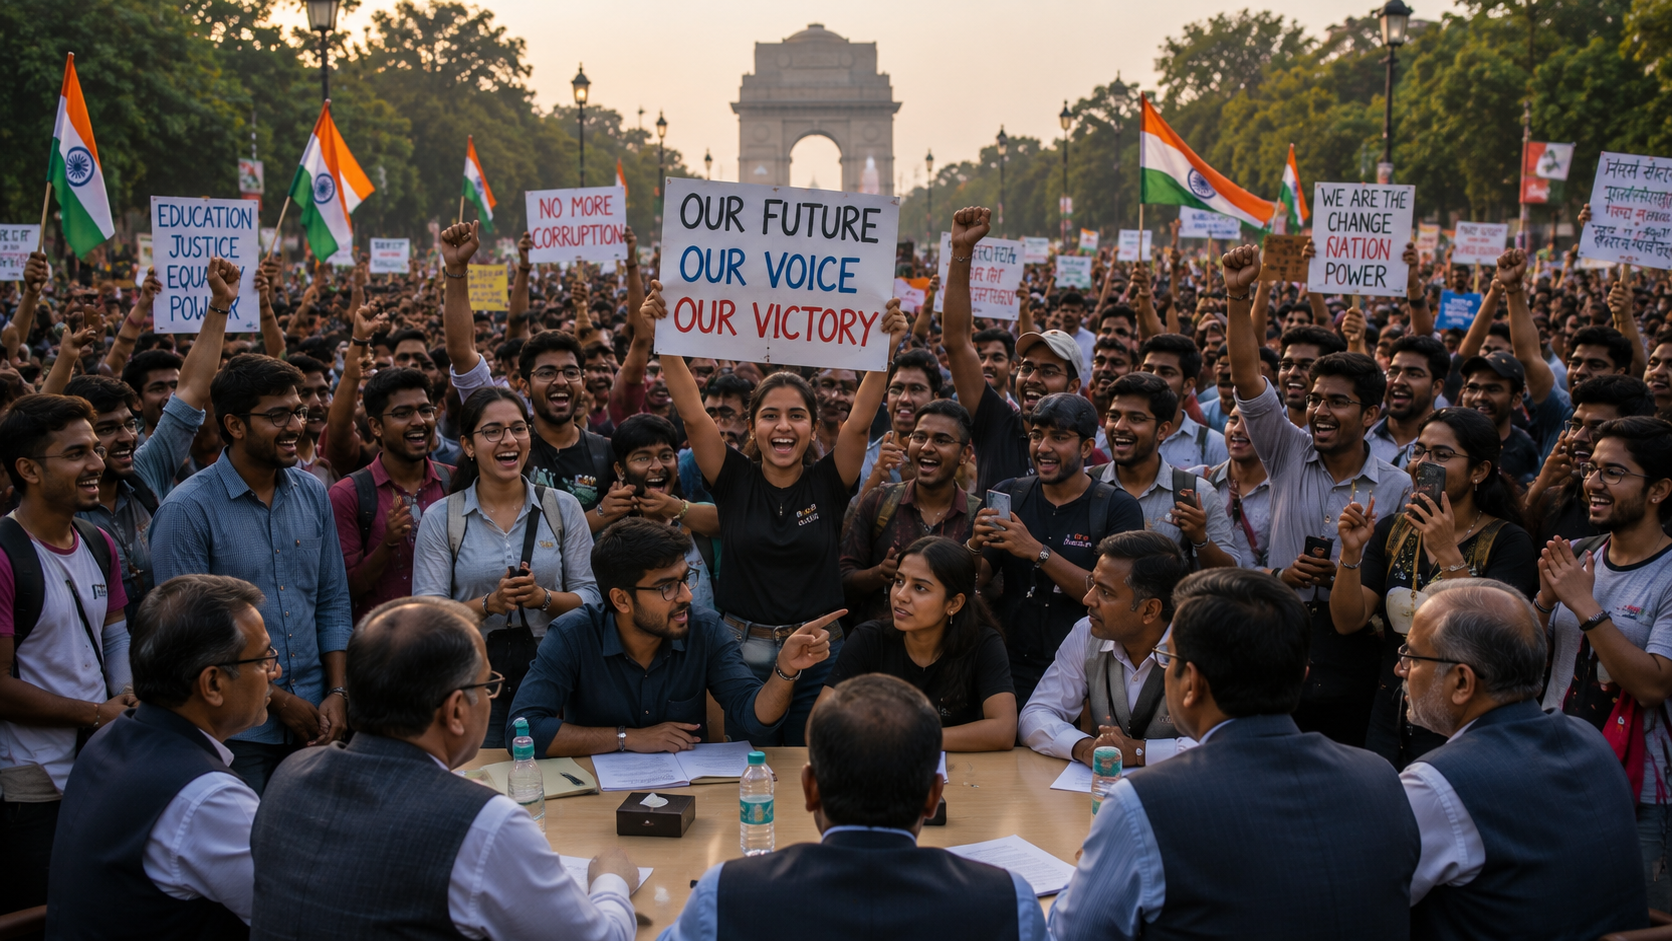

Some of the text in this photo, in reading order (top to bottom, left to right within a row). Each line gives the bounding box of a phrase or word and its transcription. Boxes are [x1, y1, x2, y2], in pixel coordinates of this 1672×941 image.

[539, 195, 613, 219] NO MORE
[1321, 187, 1408, 209] WE ARE THE
[157, 204, 252, 230] EDUCATION
[680, 193, 881, 244] OUR FUTURE
[1328, 211, 1393, 234] CHANGE
[169, 235, 240, 258] JUSTICE
[532, 223, 624, 250] CORRUPTION
[1326, 235, 1392, 261] NATION
[167, 265, 245, 292] EQUA
[680, 245, 861, 294] OUR VOICE
[1324, 261, 1387, 288] POWER
[170, 295, 241, 321] POWR
[674, 297, 879, 347] OUR VICTORY
